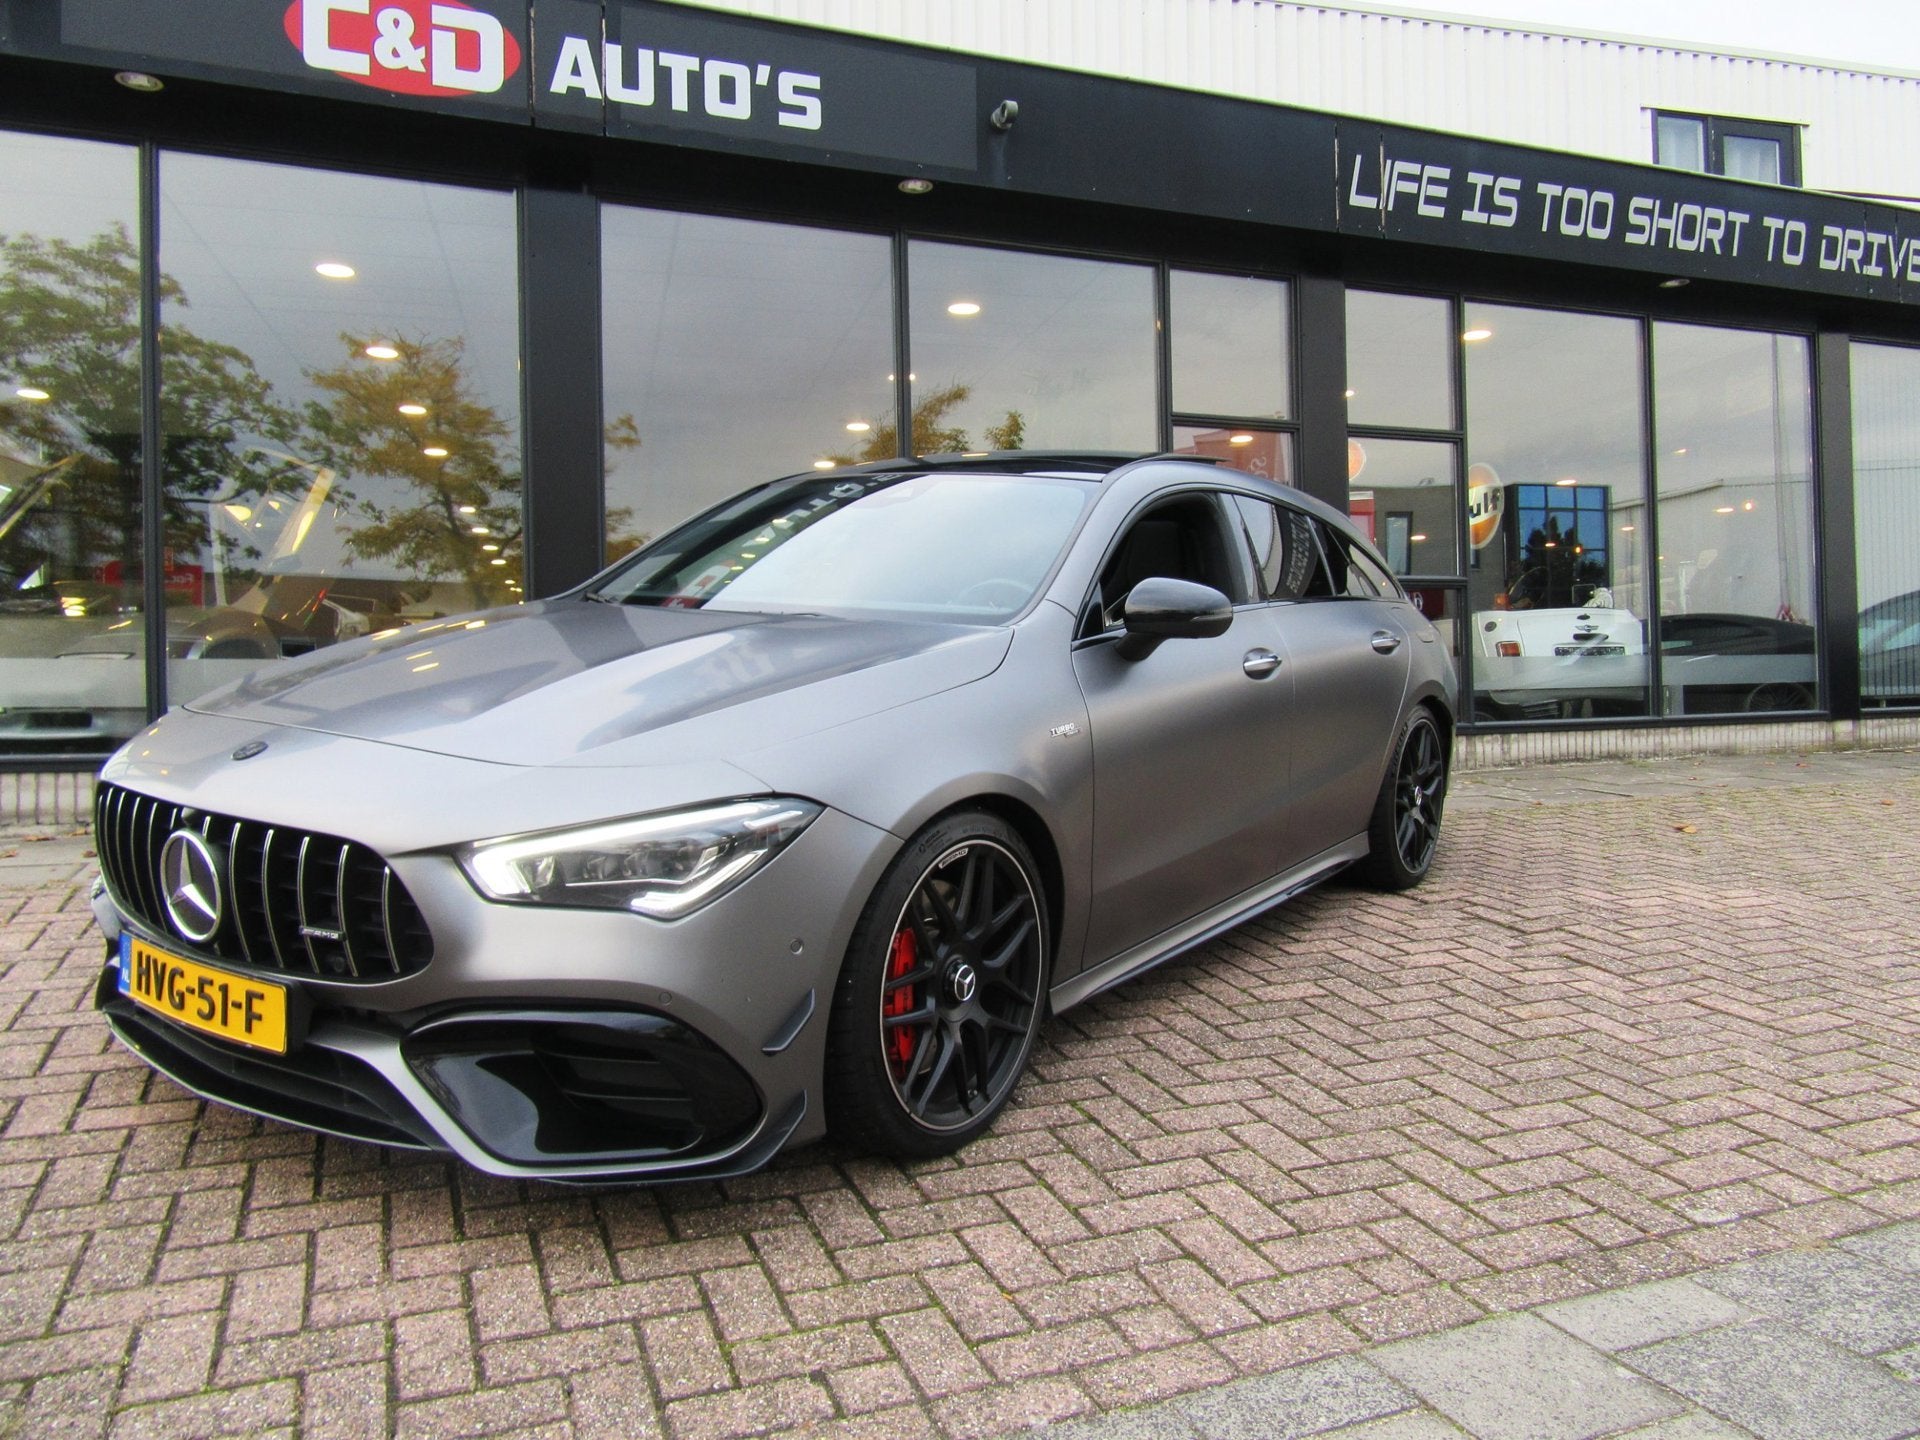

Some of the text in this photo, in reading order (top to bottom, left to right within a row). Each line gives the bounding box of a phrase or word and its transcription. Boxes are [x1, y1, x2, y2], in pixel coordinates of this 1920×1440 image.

[302, 0, 823, 131] C&D AUTO'S
[1349, 154, 1451, 218] LIFE
[1461, 171, 1522, 228] IS
[1536, 182, 1615, 240] TOO
[1625, 196, 1750, 256] SHORT
[1763, 216, 1808, 267] TO
[1469, 488, 1501, 518] ulf
[1050, 722, 1075, 735] TURBO
[121, 949, 265, 1035] NL HVG-51-F
